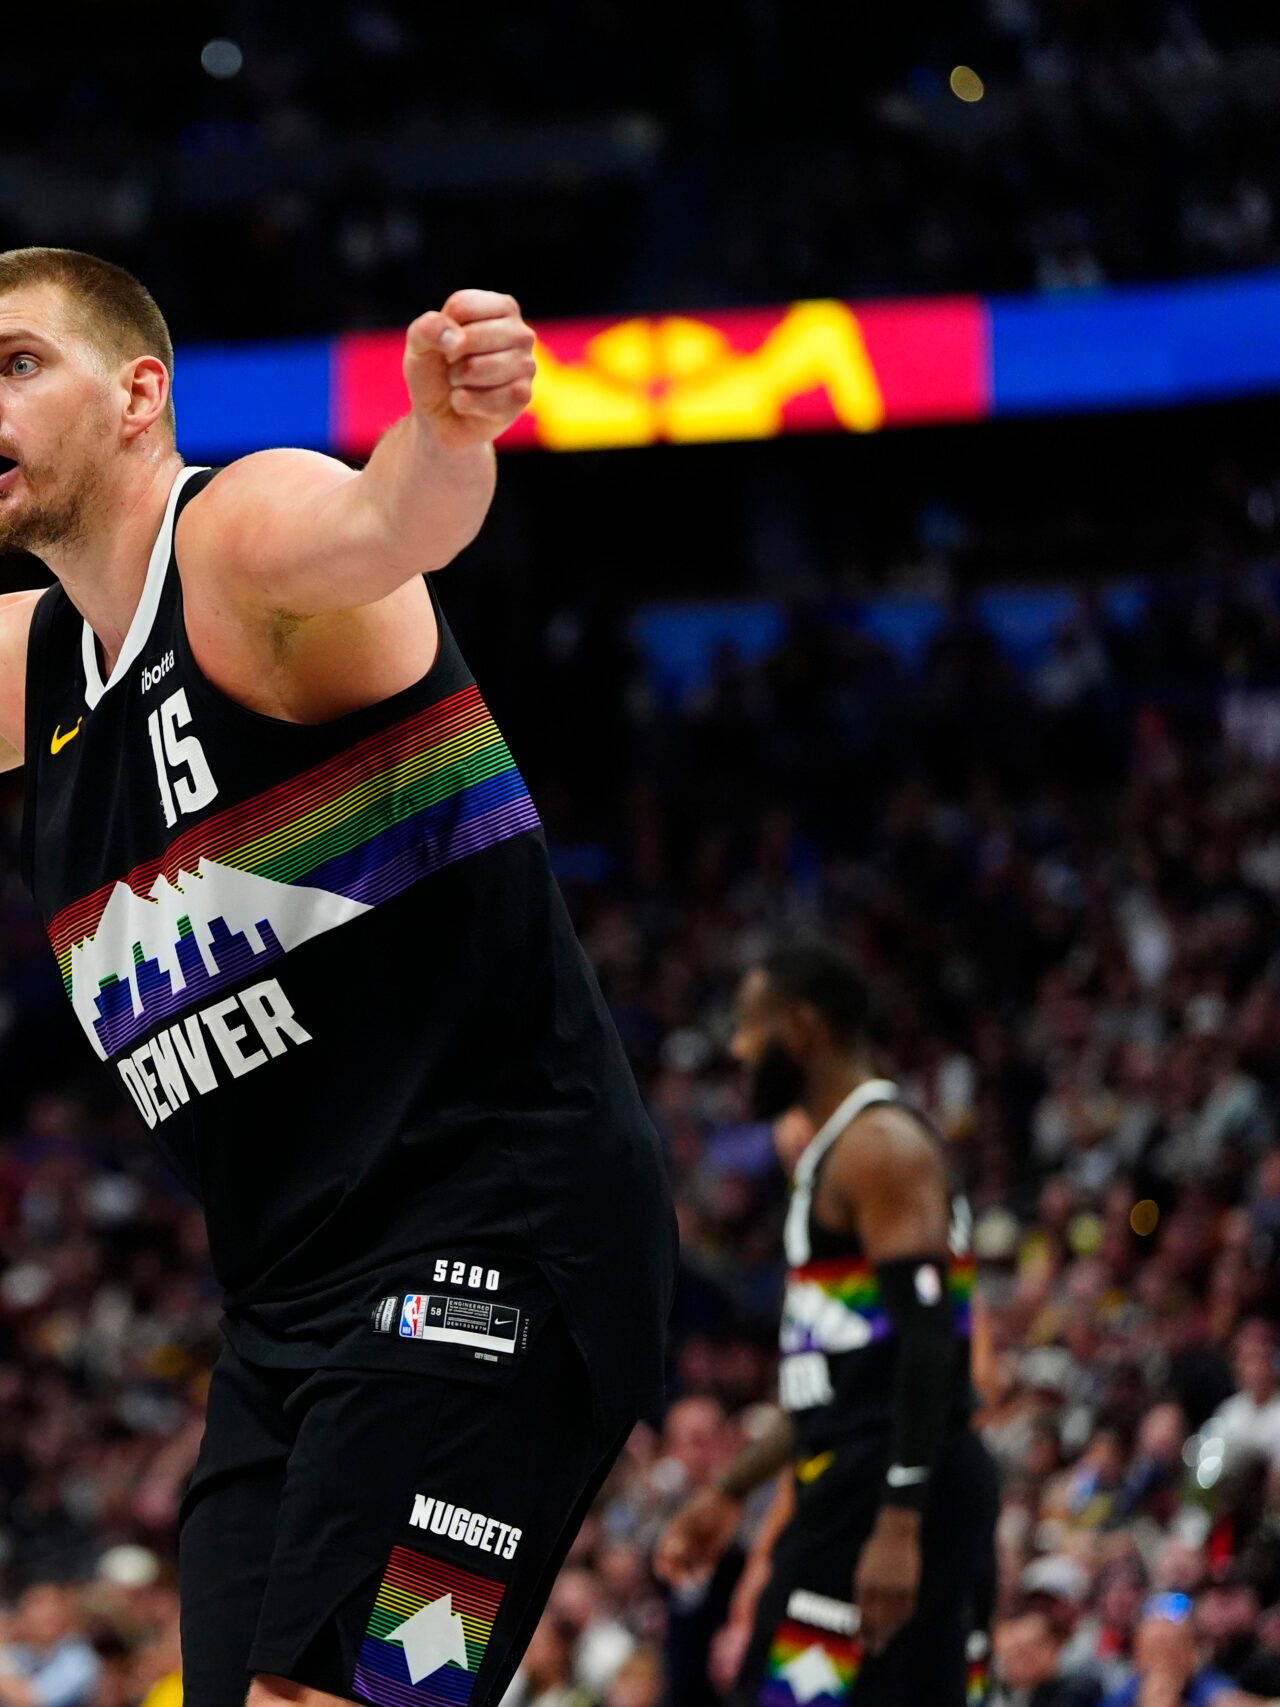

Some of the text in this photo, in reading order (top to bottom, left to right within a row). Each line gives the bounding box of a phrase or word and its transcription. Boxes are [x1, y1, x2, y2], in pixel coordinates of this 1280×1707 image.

[141, 649, 175, 695] ibotta
[148, 687, 219, 829] 15
[116, 977, 314, 1130] DENVER
[433, 1259, 500, 1291] 5280
[430, 1307, 442, 1316] 58
[449, 1300, 490, 1311] ENGINEERED
[409, 1493, 522, 1560] NUGGETS
